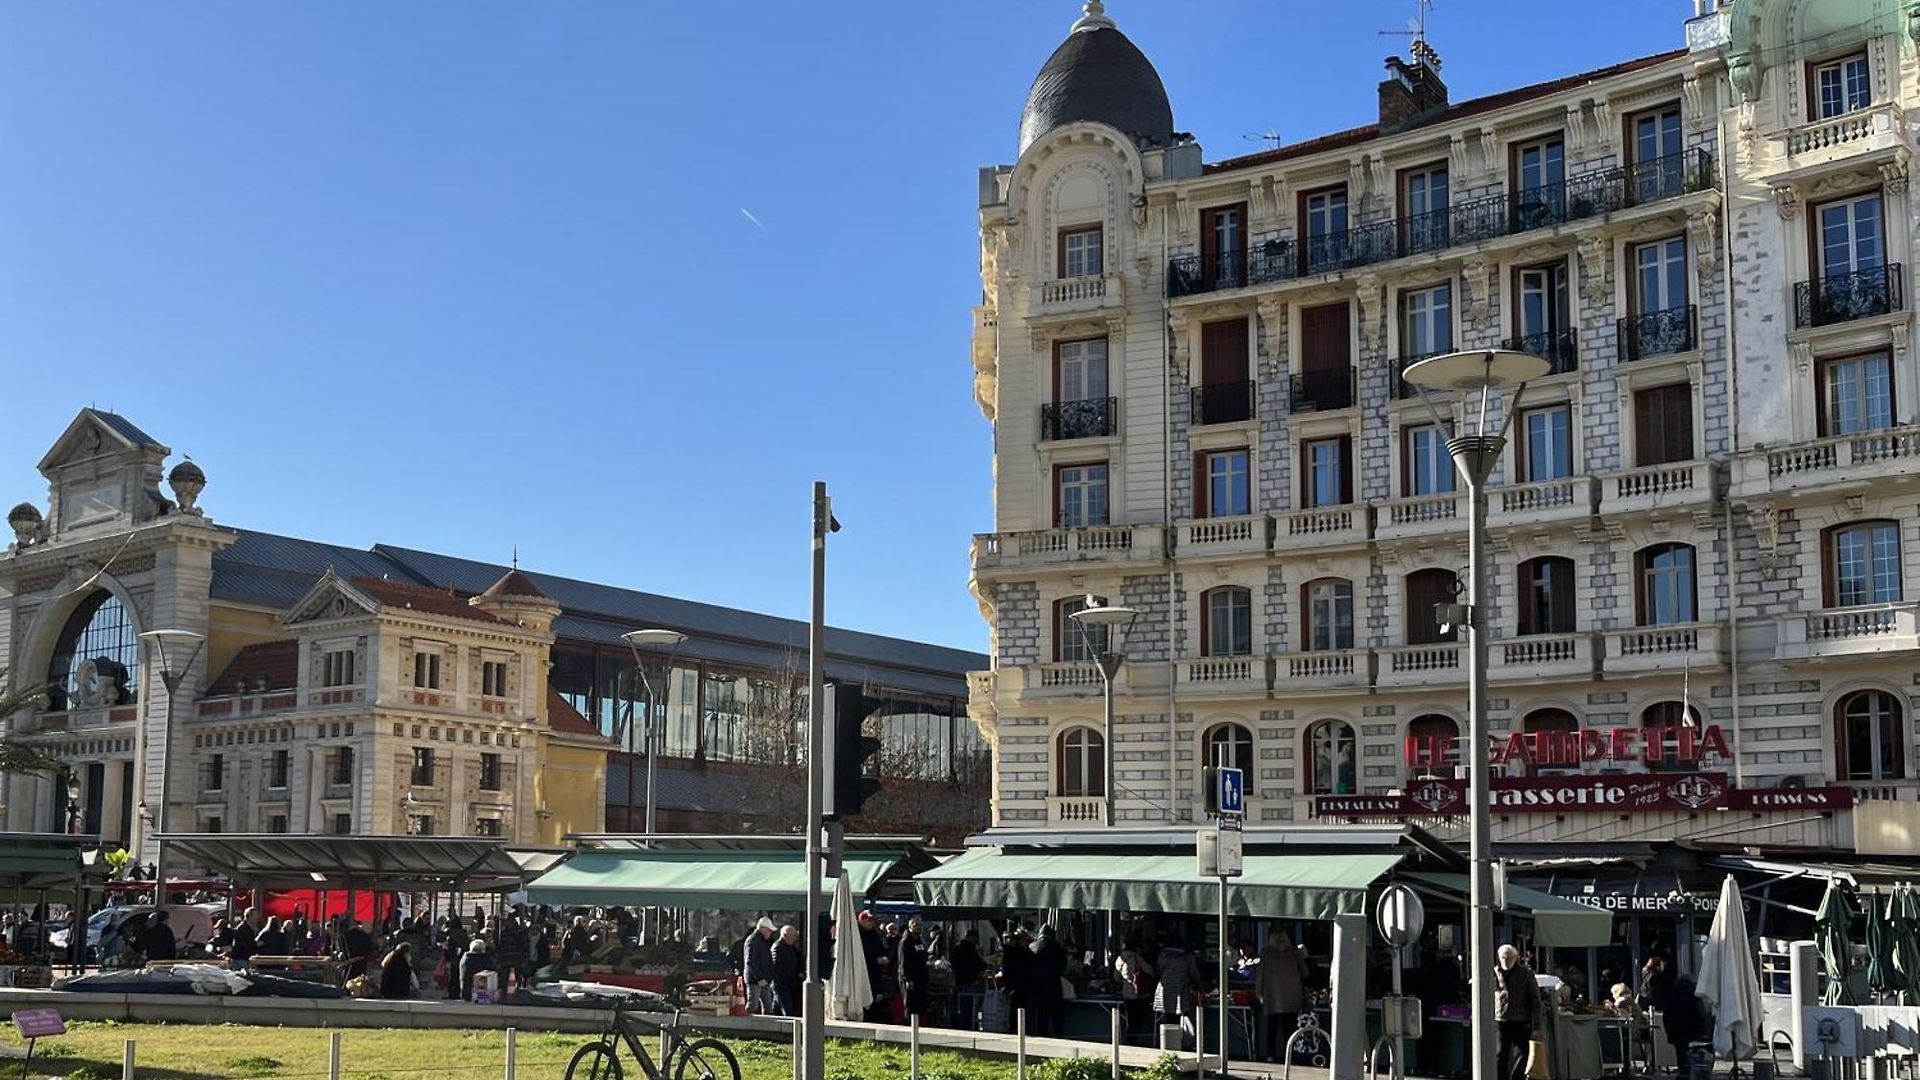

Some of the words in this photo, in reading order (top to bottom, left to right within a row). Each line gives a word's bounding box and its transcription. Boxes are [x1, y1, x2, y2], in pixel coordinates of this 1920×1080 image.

[1404, 735, 1453, 767] LE
[1465, 782, 1626, 806] rasserie
[1321, 800, 1400, 812] RESTAURANT
[1605, 896, 1628, 909] DE
[1632, 897, 1668, 910] MER
